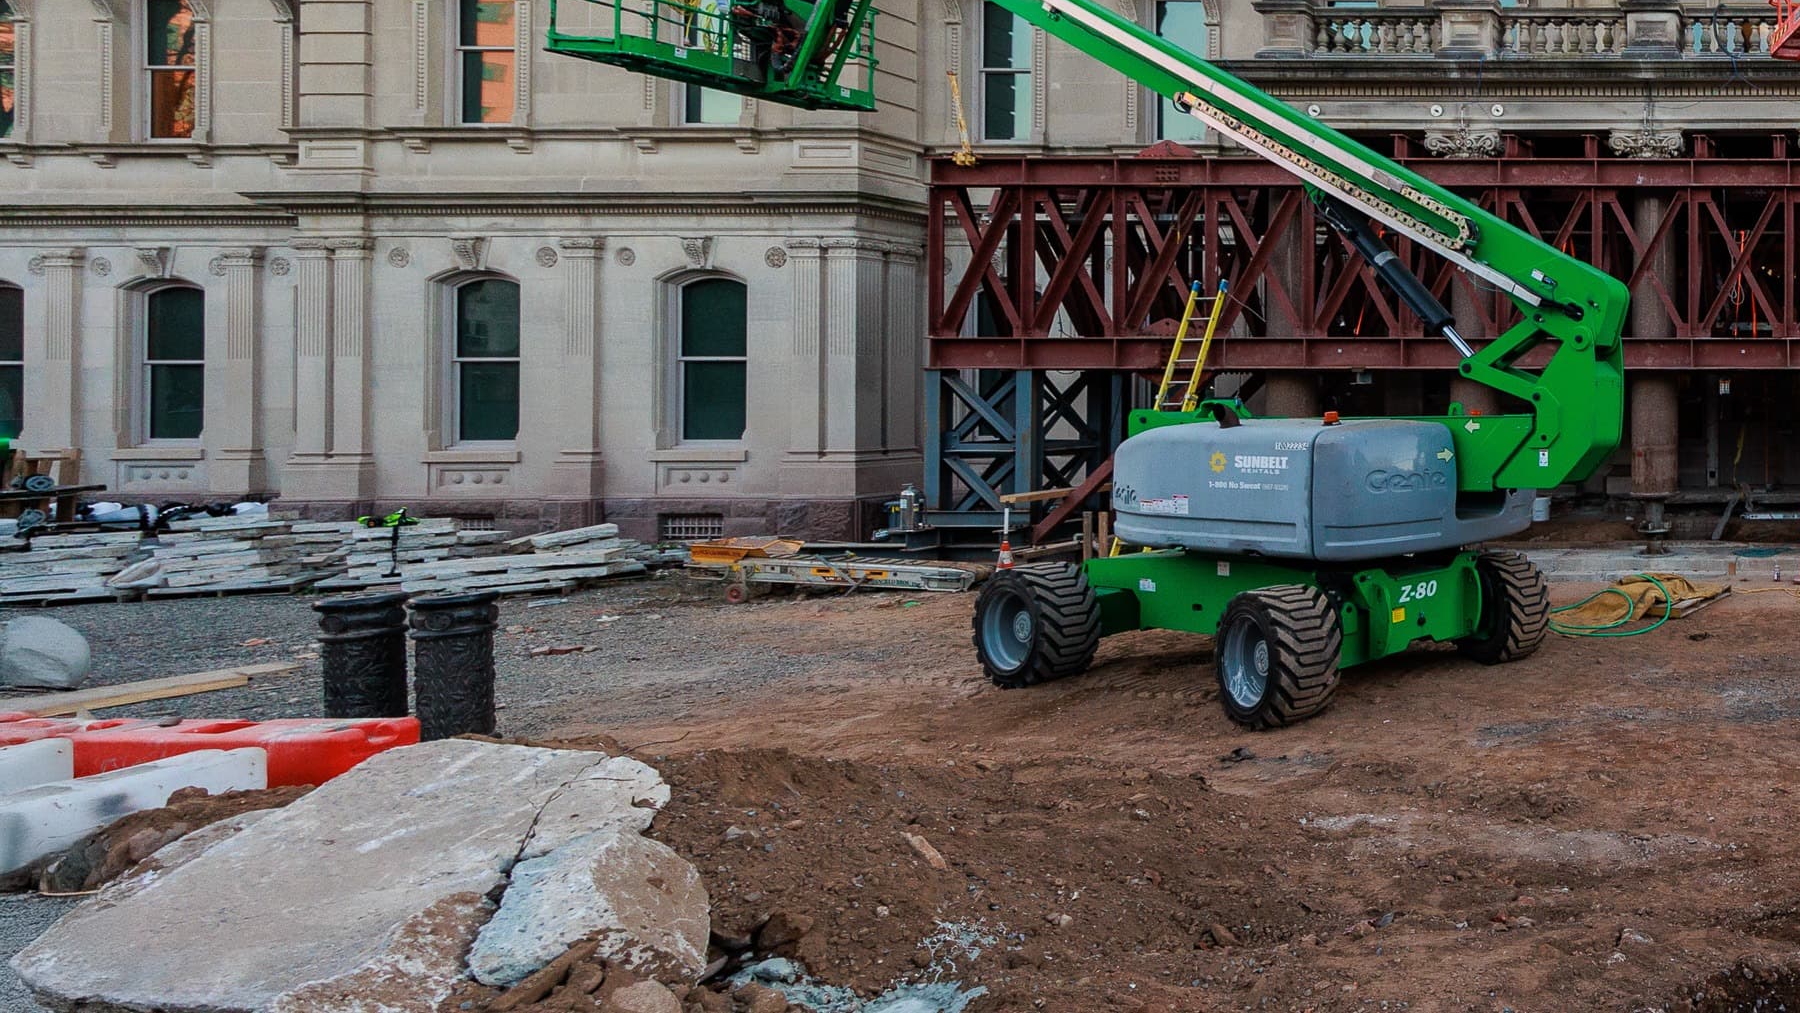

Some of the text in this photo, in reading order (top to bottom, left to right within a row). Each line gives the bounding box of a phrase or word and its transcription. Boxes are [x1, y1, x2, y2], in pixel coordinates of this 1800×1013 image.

[1234, 455, 1288, 469] SUNBELT
[1364, 469, 1446, 494] Genie
[1399, 580, 1437, 603] Z-80
